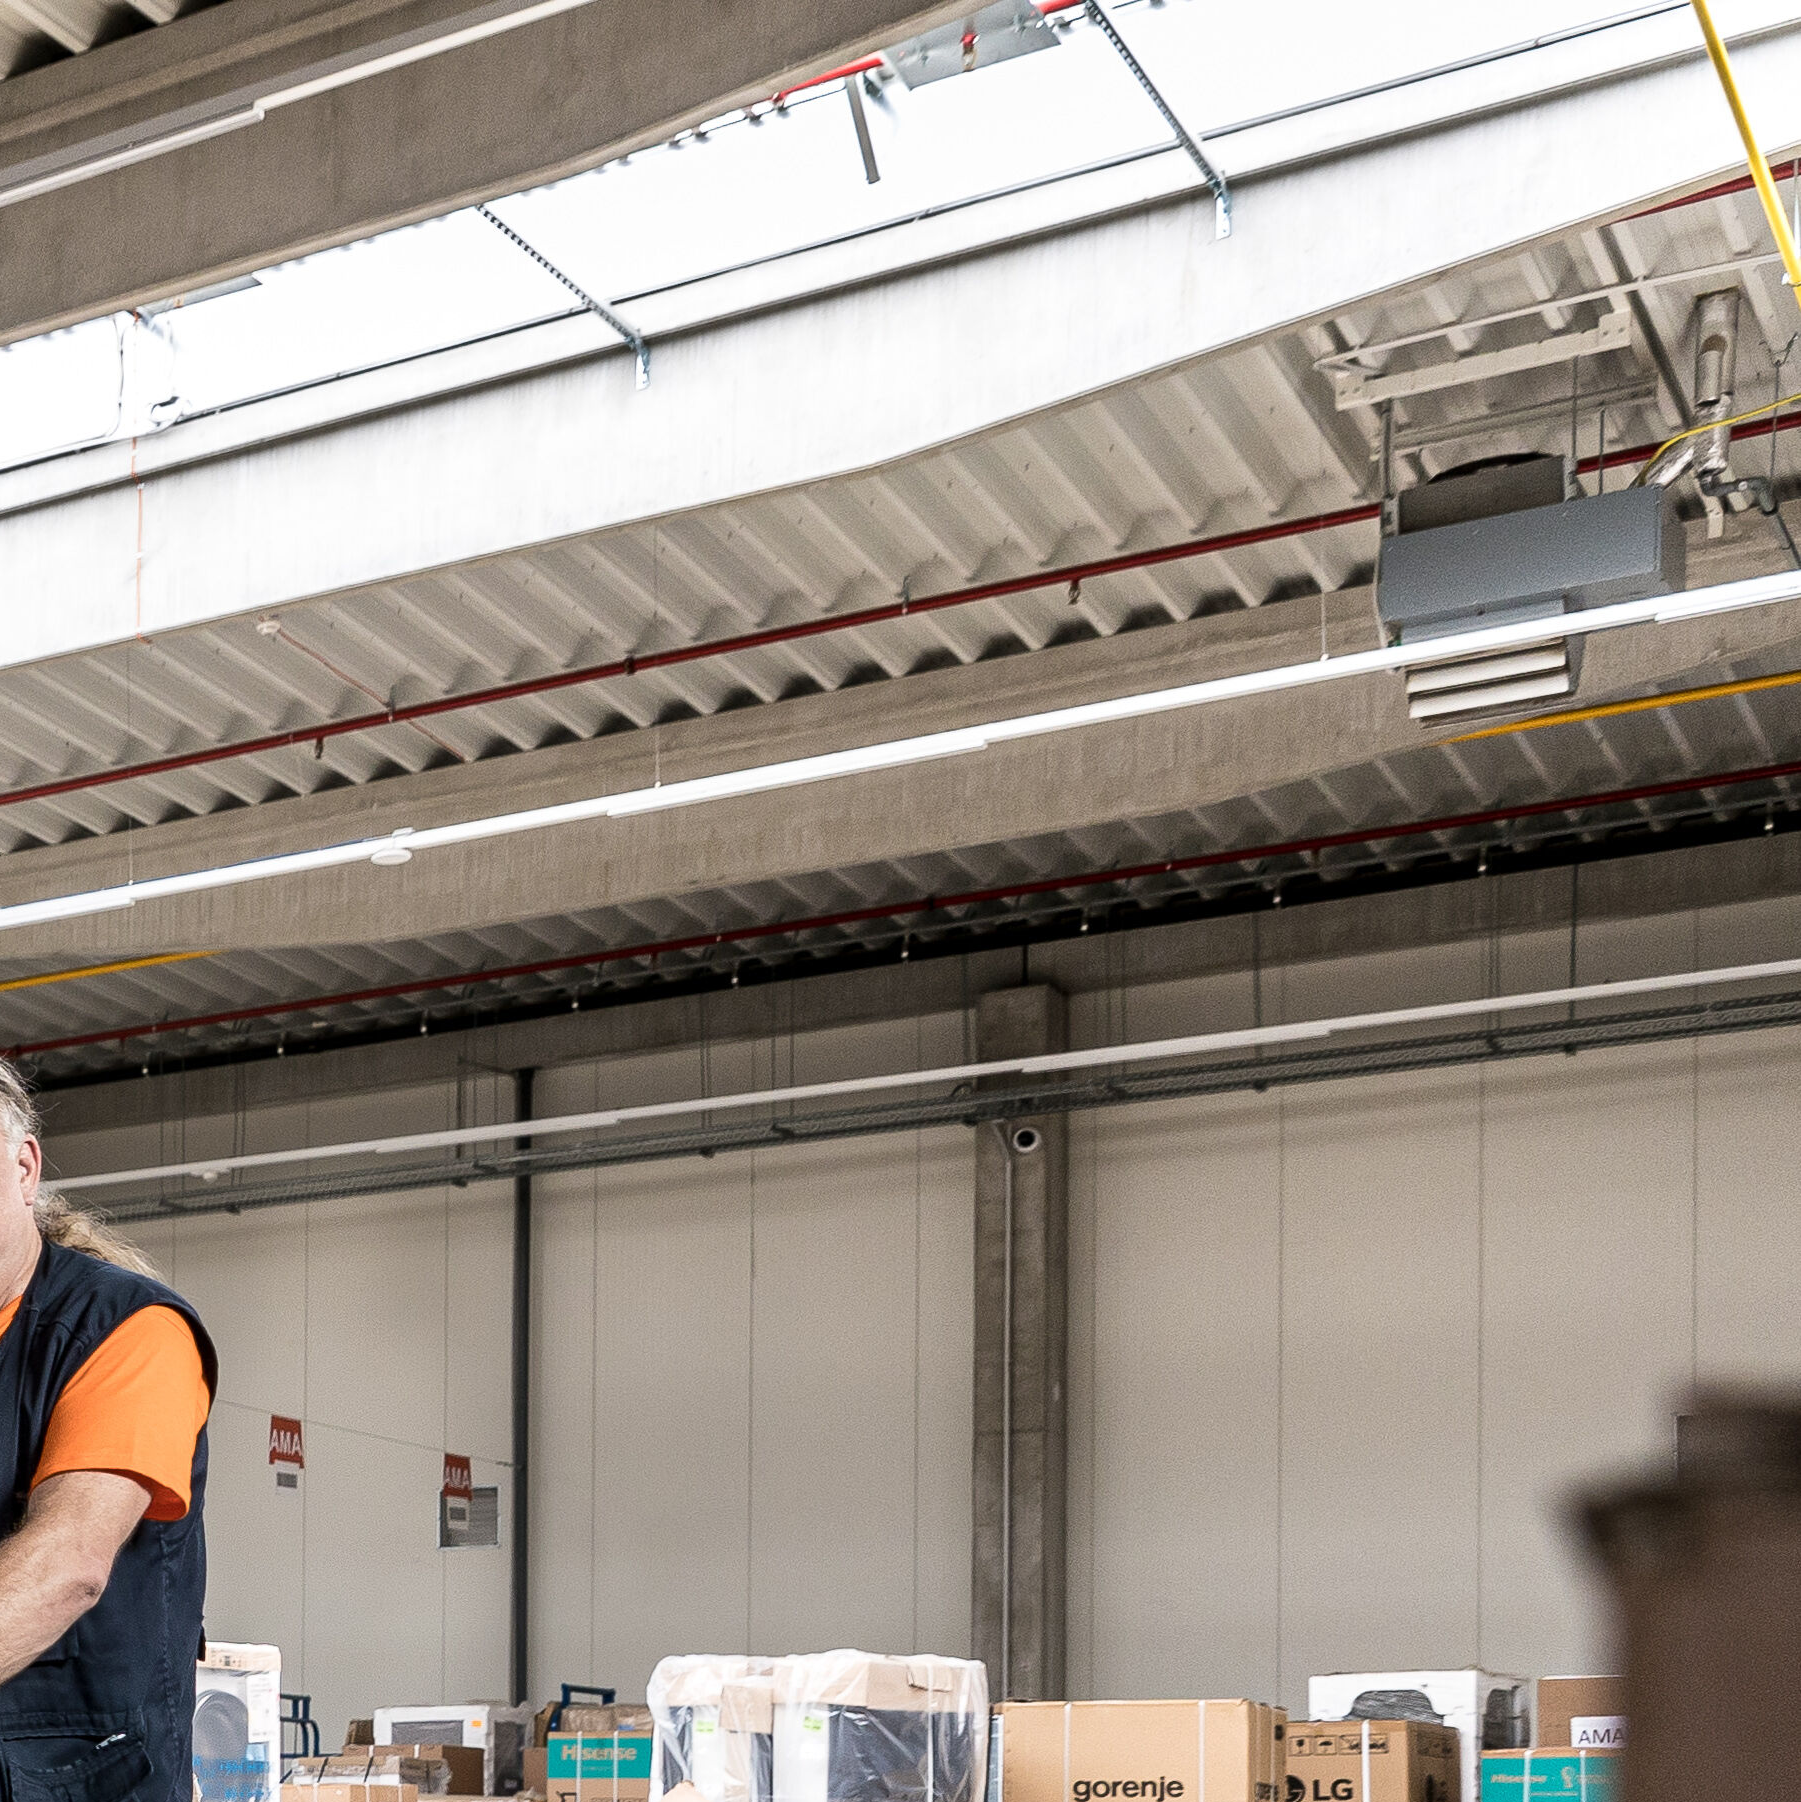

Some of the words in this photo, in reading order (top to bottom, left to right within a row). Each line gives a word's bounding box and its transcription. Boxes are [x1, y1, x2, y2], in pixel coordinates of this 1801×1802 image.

[561, 1744, 637, 1760] Hisense
[1073, 1776, 1184, 1802] gorenje
[1312, 1778, 1354, 1801] LG
